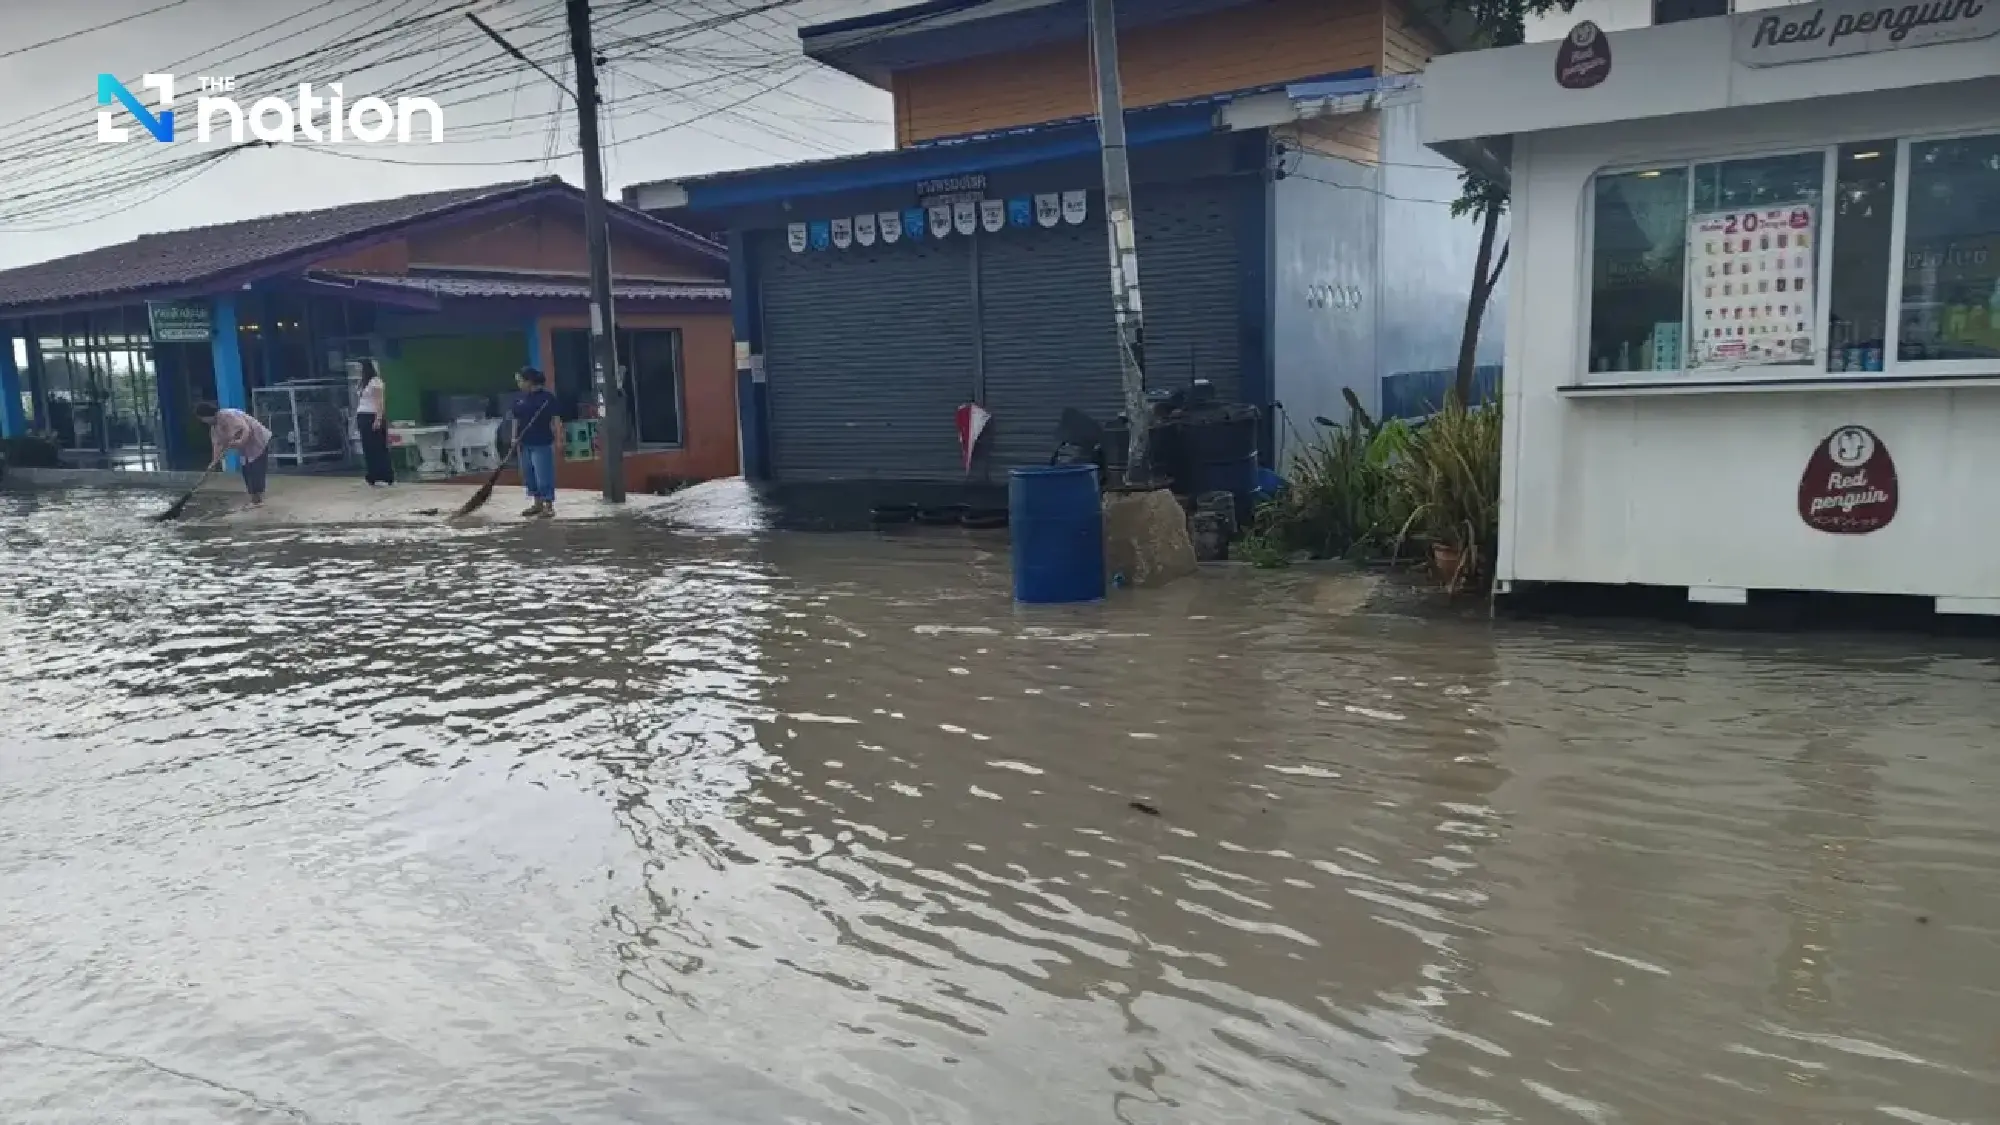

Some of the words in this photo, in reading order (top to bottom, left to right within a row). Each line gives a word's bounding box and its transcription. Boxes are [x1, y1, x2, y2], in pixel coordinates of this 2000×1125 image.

[1752, 8, 1826, 48] Red
[1828, 0, 1984, 47] penguin
[1828, 468, 1868, 489] Red
[1810, 485, 1888, 516] penguin
